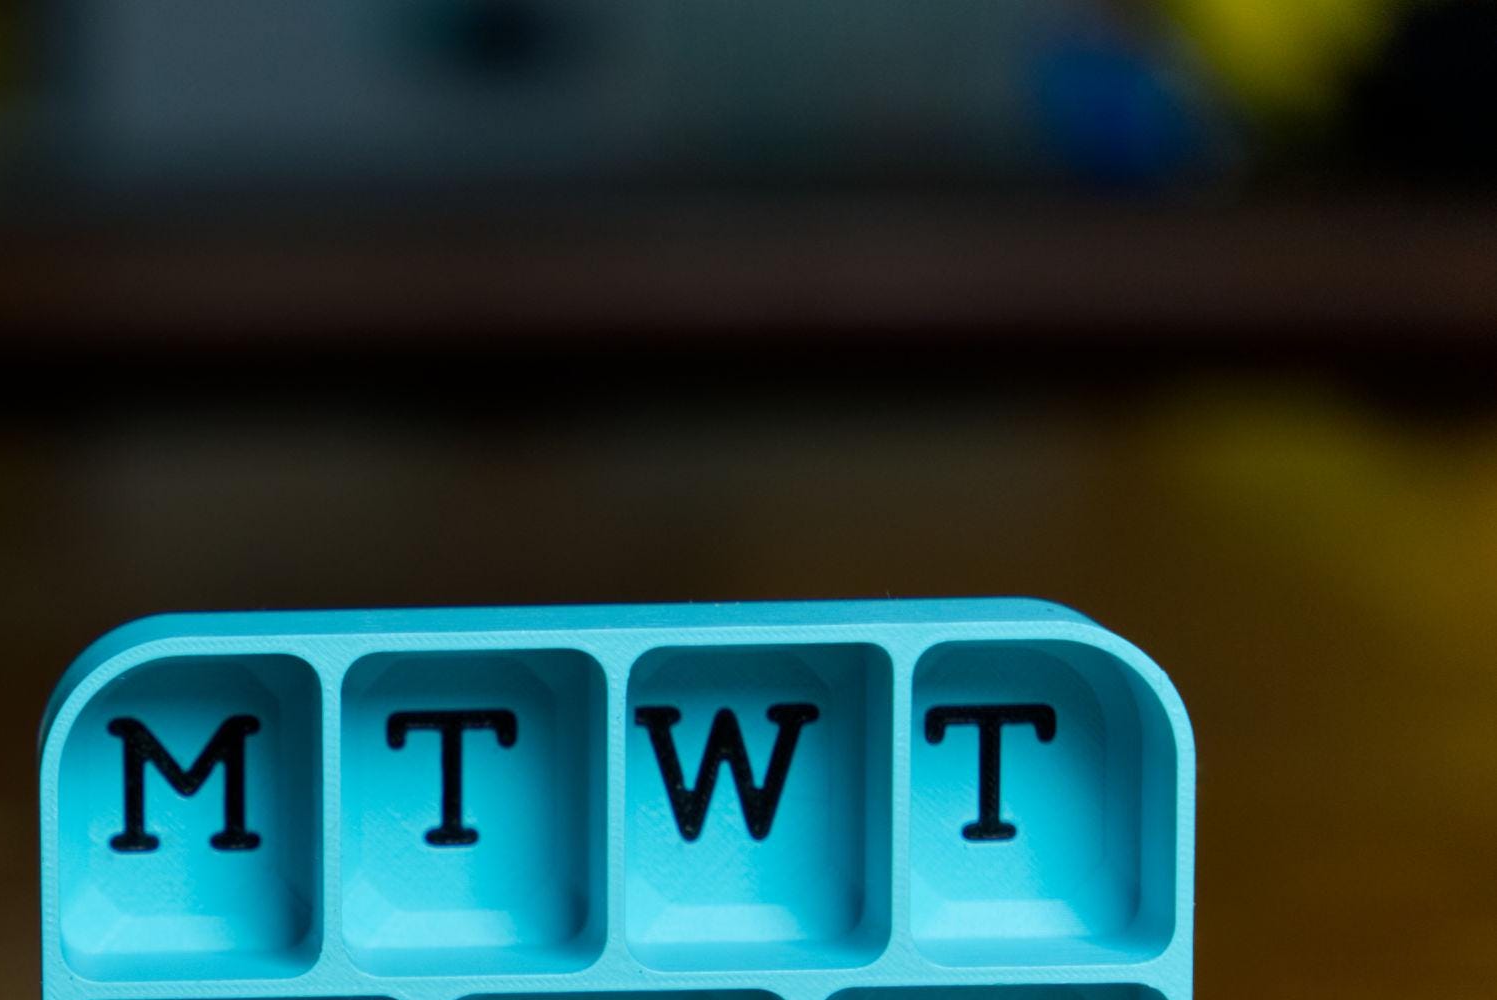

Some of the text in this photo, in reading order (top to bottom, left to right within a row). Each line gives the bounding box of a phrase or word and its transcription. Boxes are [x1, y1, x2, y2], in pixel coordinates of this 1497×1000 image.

[108, 701, 1058, 851] M T W T
